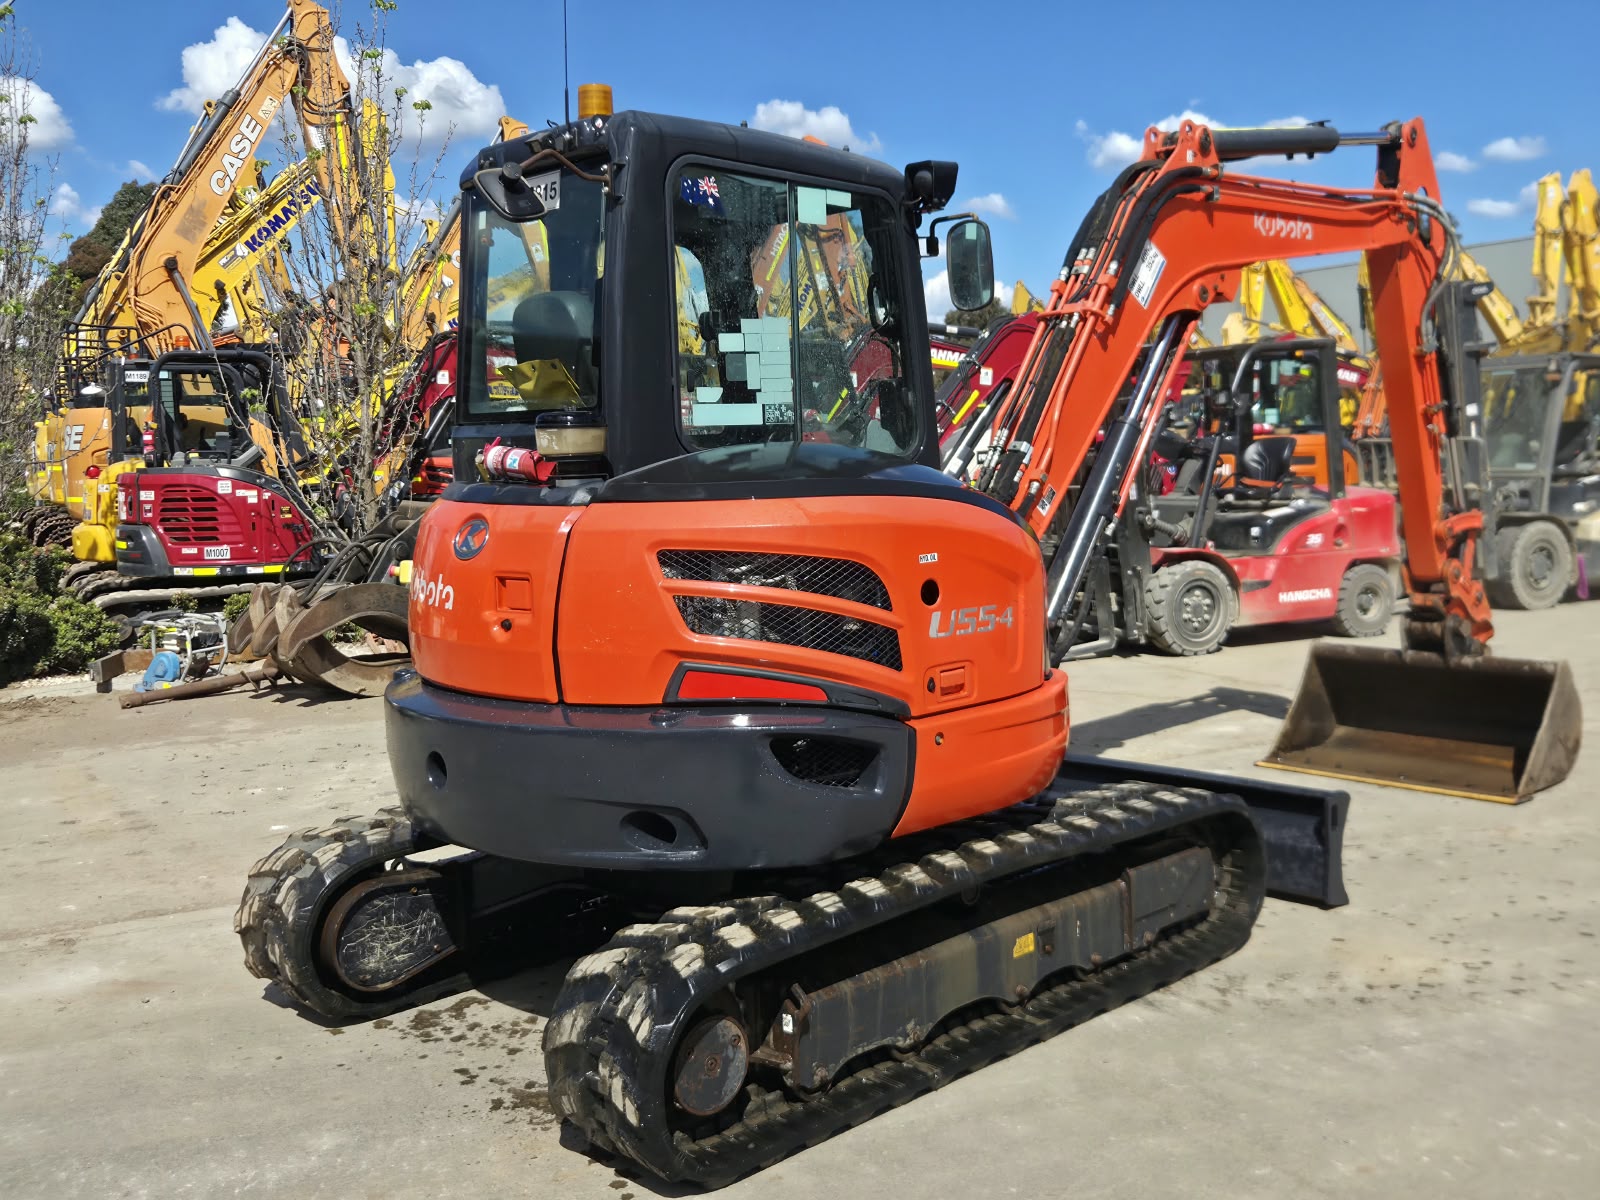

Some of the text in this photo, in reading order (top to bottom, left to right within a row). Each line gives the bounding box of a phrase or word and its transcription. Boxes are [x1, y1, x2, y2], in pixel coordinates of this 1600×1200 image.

[210, 113, 263, 197] CASE
[533, 181, 558, 201] 815
[1253, 211, 1313, 241] Kubota
[205, 548, 229, 558] M1007
[1278, 587, 1332, 603] HANGCHA
